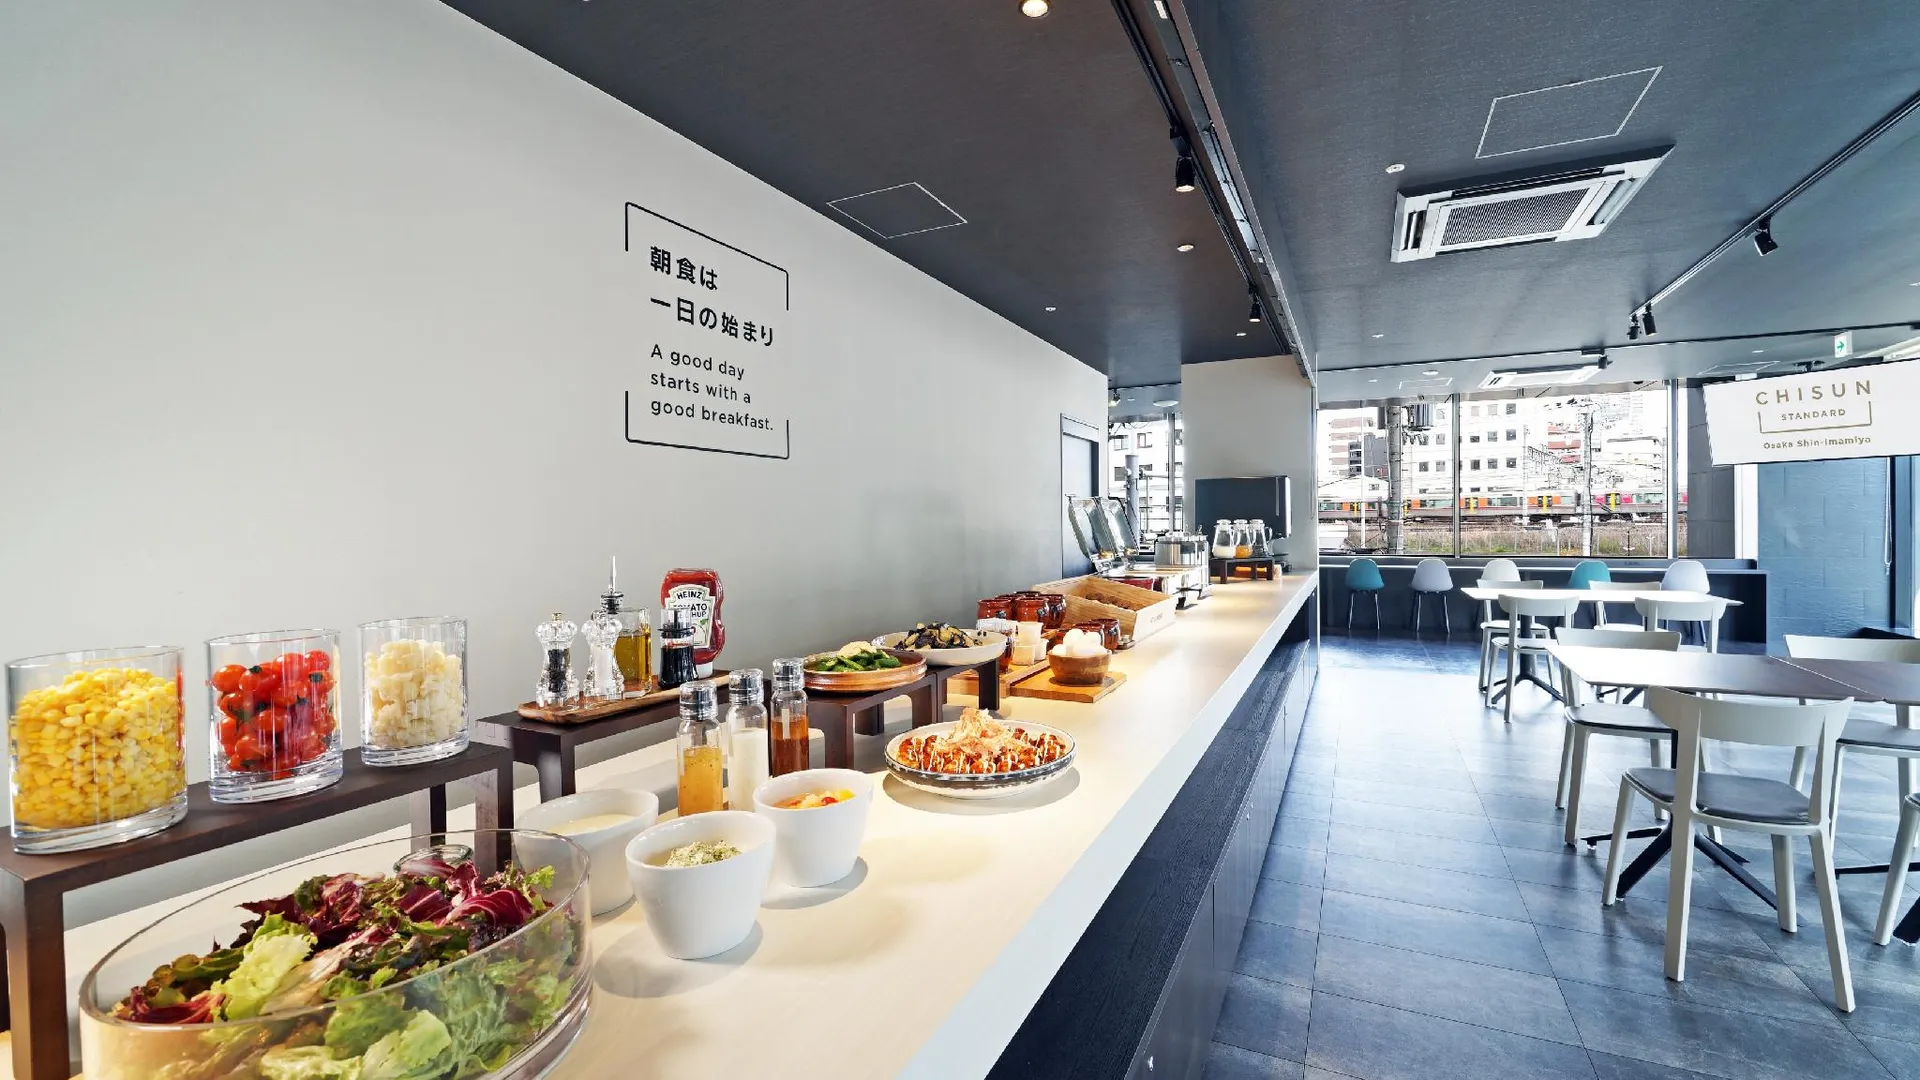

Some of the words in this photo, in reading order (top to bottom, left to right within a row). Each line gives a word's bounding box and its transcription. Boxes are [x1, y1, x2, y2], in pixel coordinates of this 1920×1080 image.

[650, 246, 718, 290] 朝食は
[650, 297, 773, 347] 一日の始まり
[650, 344, 663, 360] A
[670, 352, 713, 372] good
[718, 361, 745, 381] day
[650, 373, 700, 394] starts
[705, 384, 738, 401] with
[743, 393, 751, 404] a
[1755, 380, 1871, 406] CHISUN
[650, 401, 695, 418] good
[701, 406, 774, 431] breakfast.
[1781, 408, 1846, 421] STANDARD
[1763, 441, 1794, 450] Osaka
[1796, 436, 1872, 448] Shin-Imamiya
[676, 590, 703, 600] HEINZ
